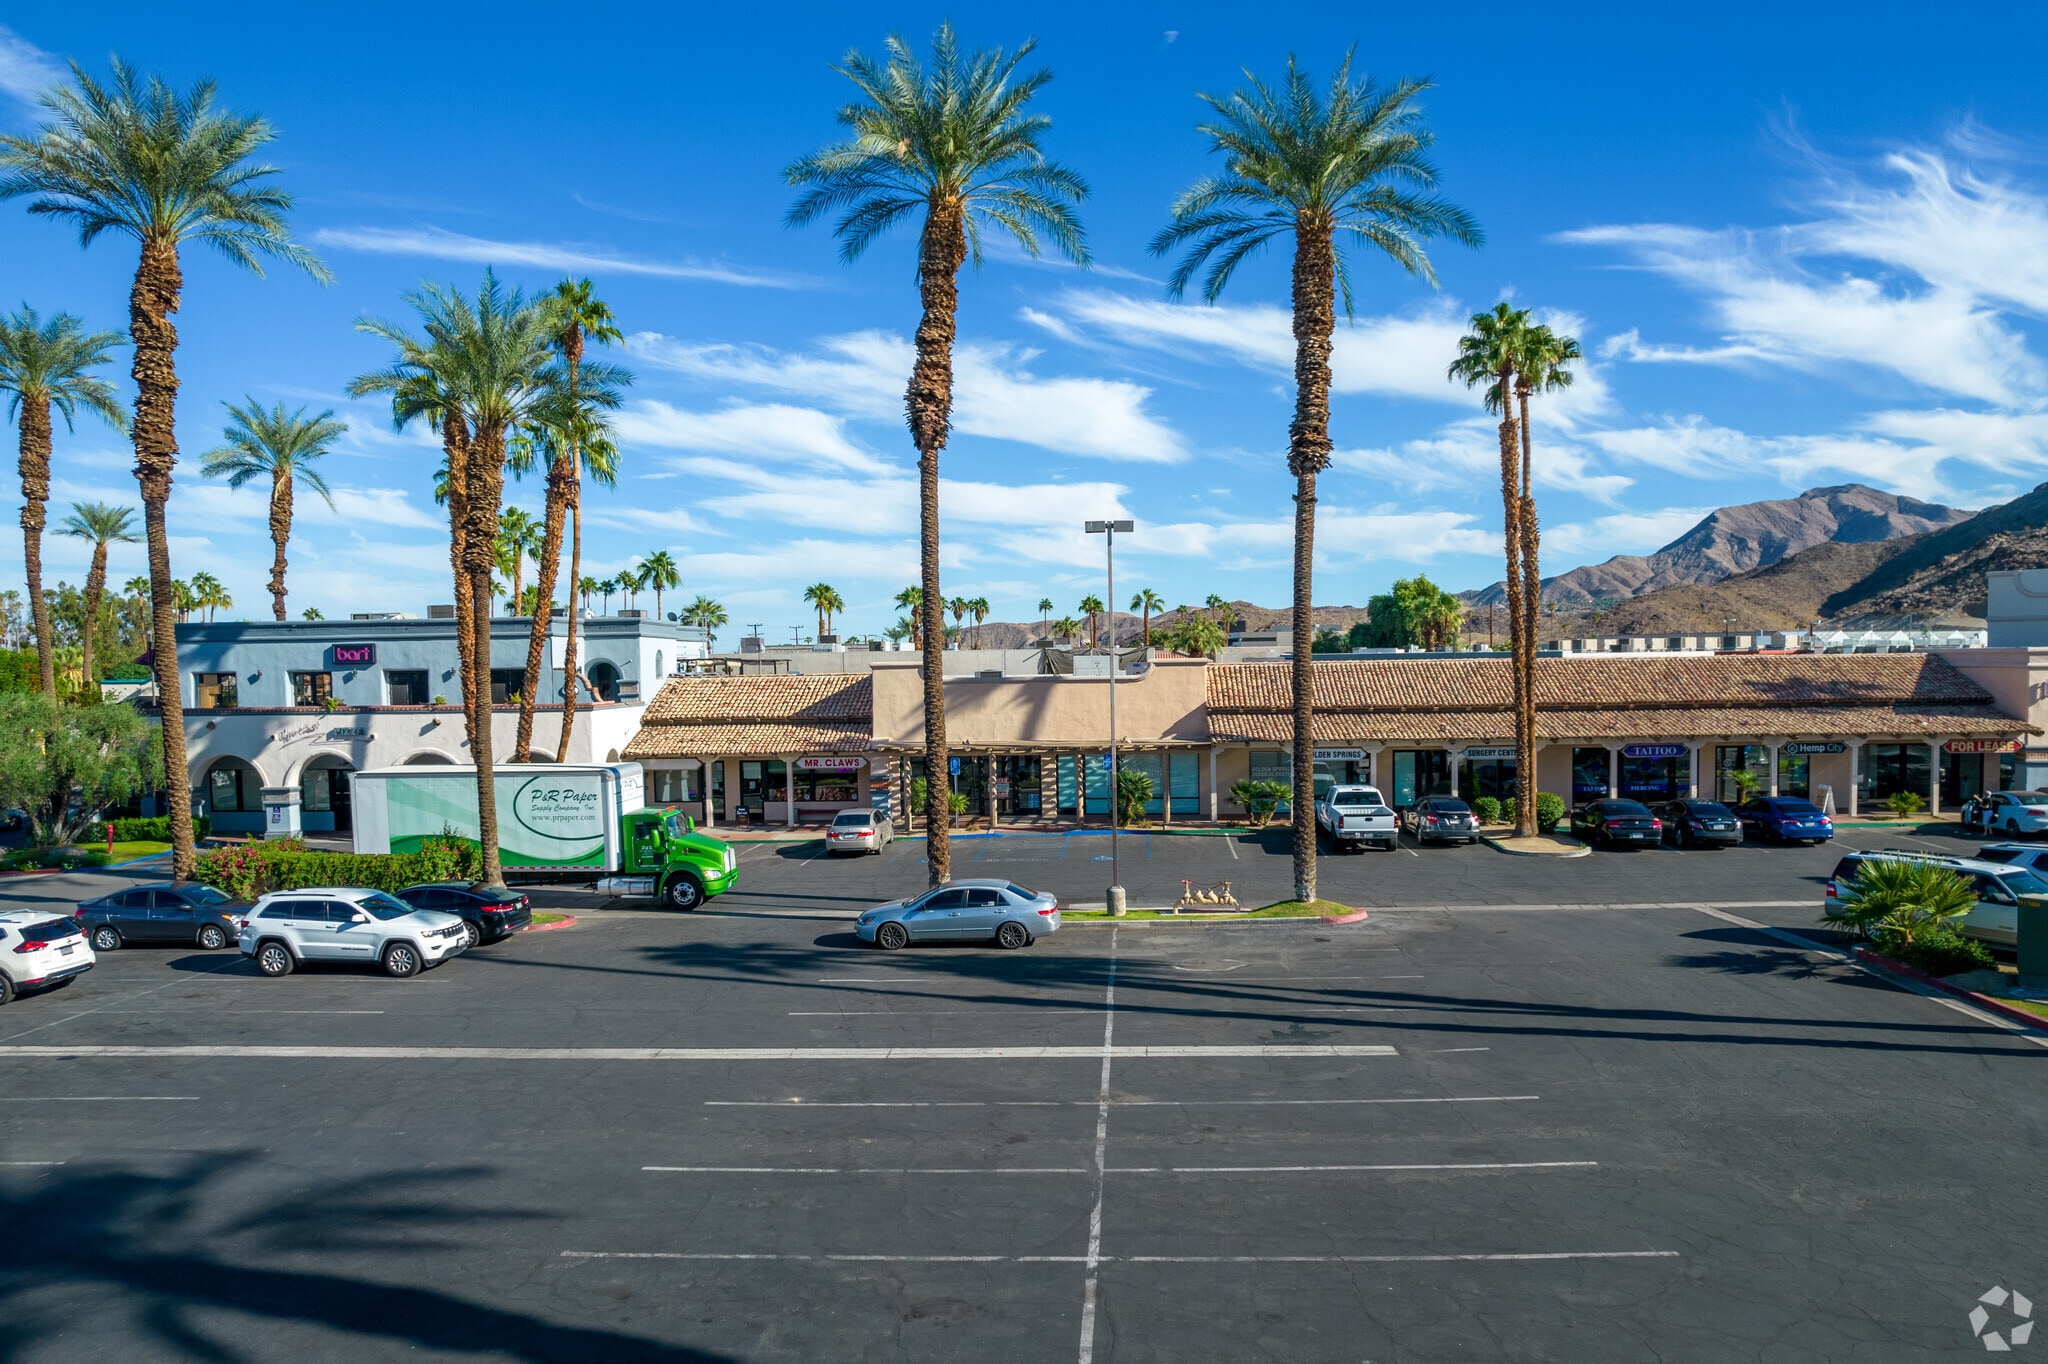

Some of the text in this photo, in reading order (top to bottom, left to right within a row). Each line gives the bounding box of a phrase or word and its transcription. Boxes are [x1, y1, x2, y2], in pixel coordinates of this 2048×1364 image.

[336, 647, 370, 661] bart
[333, 727, 365, 736] PIZZA
[1634, 746, 1677, 755] TATTOO
[1800, 743, 1826, 753] Hemp
[1826, 743, 1843, 753] City
[1951, 741, 2015, 752] FOR LEASE
[1332, 750, 1362, 759] SPRINGS
[1467, 749, 1518, 757] SURGERY CENTE
[804, 759, 860, 767] MR. CLAWS
[531, 789, 598, 804] P&R Paper
[531, 804, 552, 812] Supply
